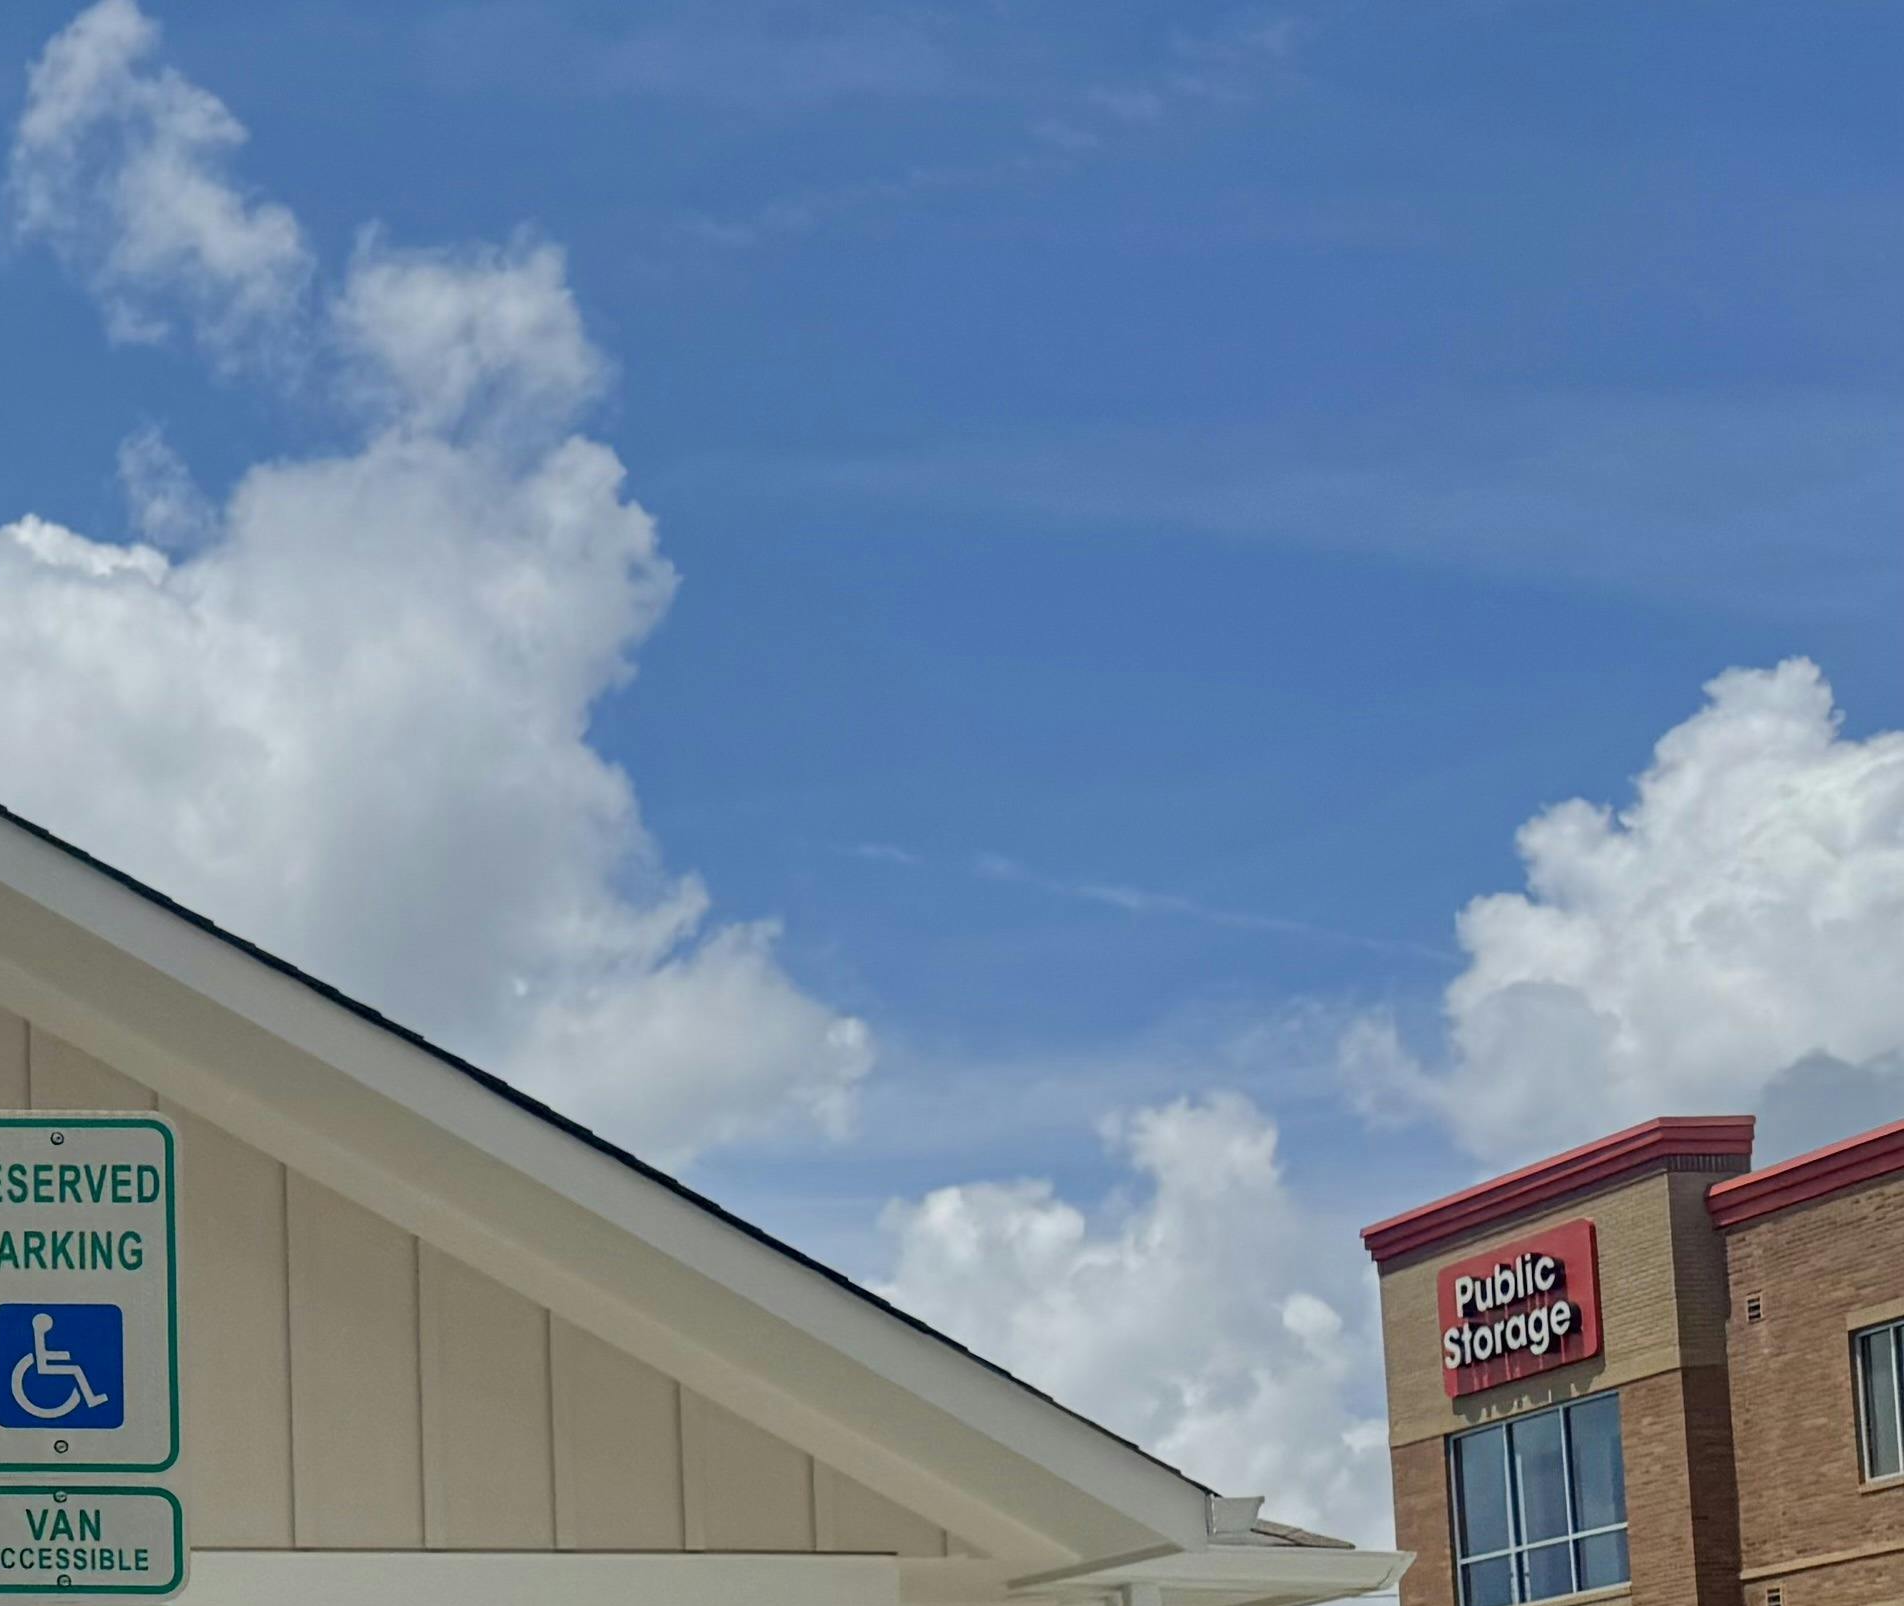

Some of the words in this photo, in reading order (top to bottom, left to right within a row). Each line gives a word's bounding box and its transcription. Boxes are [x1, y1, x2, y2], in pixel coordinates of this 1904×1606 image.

[1455, 1252, 1556, 1319] Public
[1443, 1300, 1572, 1370] Storage
[25, 1508, 102, 1542] VAN
